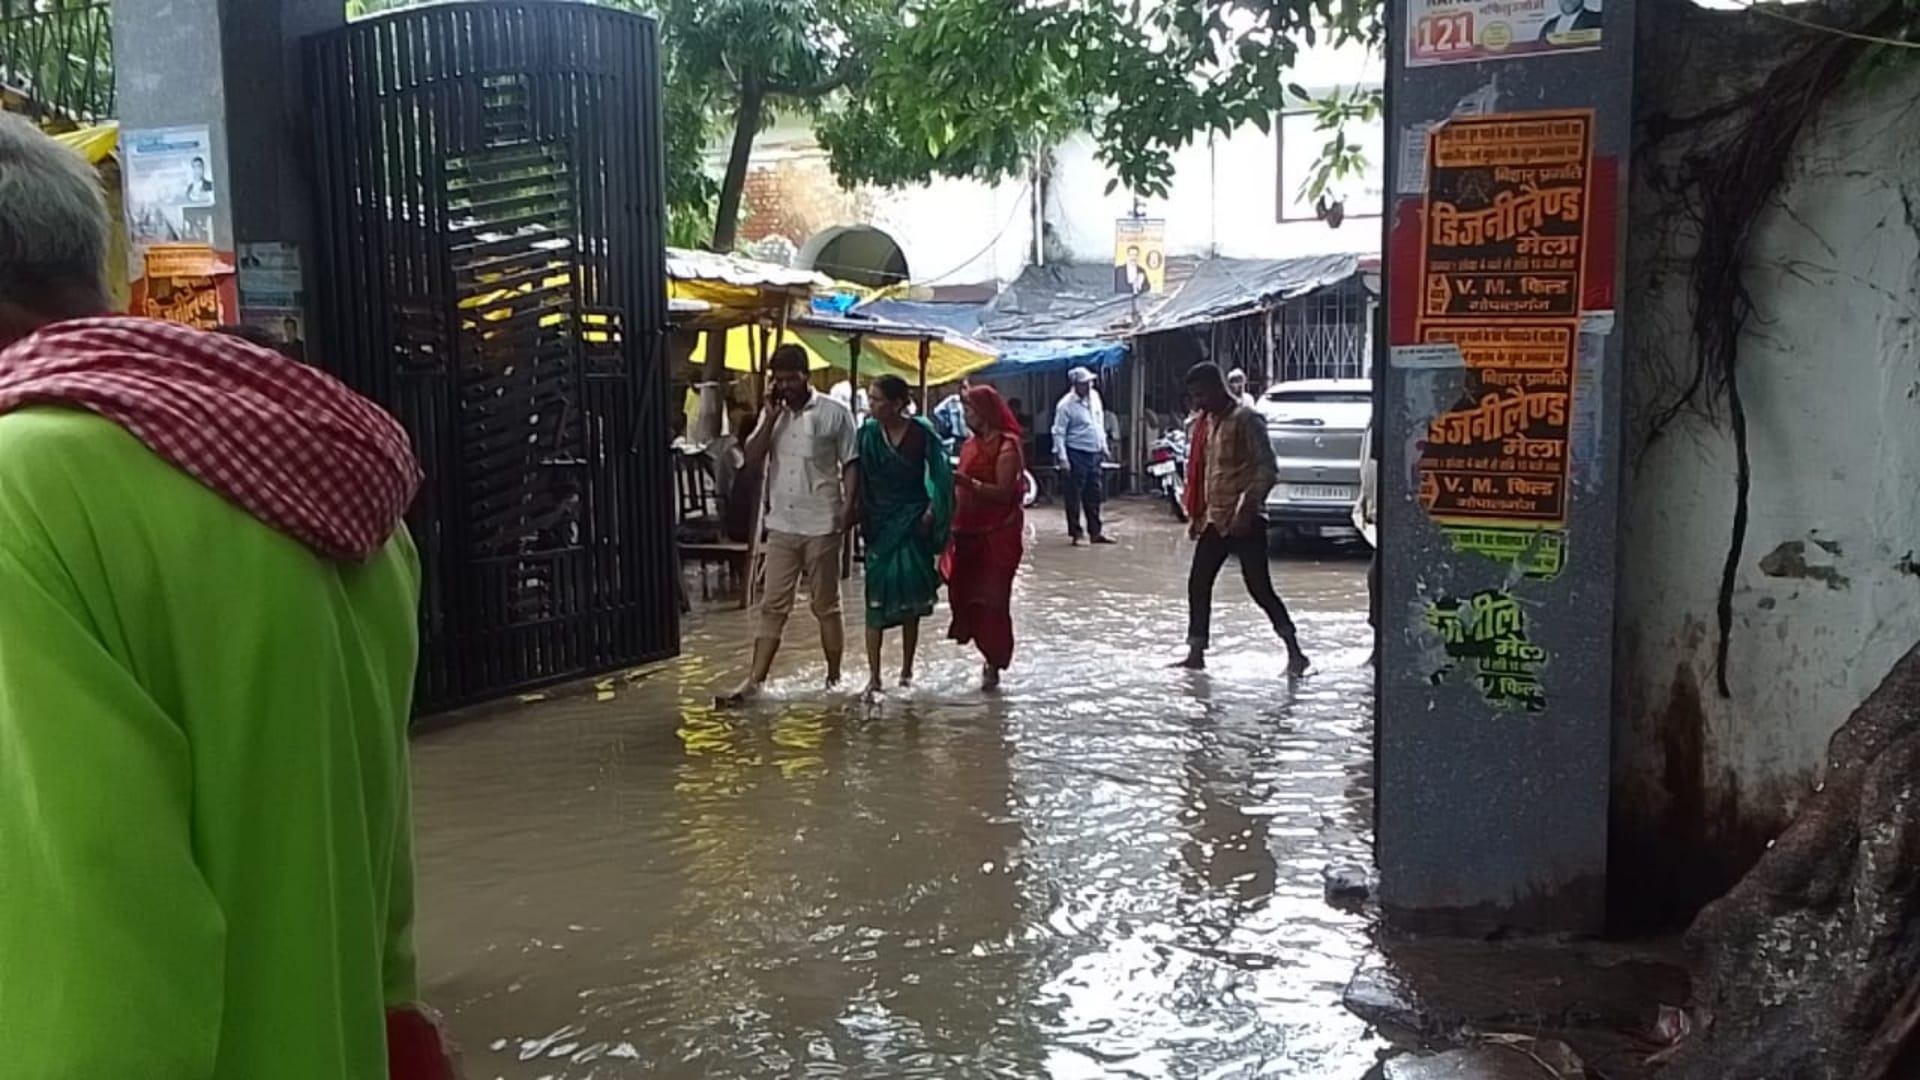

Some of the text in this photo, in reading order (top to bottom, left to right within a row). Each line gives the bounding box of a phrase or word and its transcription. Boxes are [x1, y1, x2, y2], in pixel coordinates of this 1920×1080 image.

[1418, 16, 1473, 50] 121
[1516, 230, 1580, 255] मेला
[1456, 279, 1477, 295] V.
[1485, 279, 1512, 295] M.
[1502, 432, 1564, 458] मेला
[1444, 477, 1464, 493] V.
[1472, 478, 1499, 494] M.
